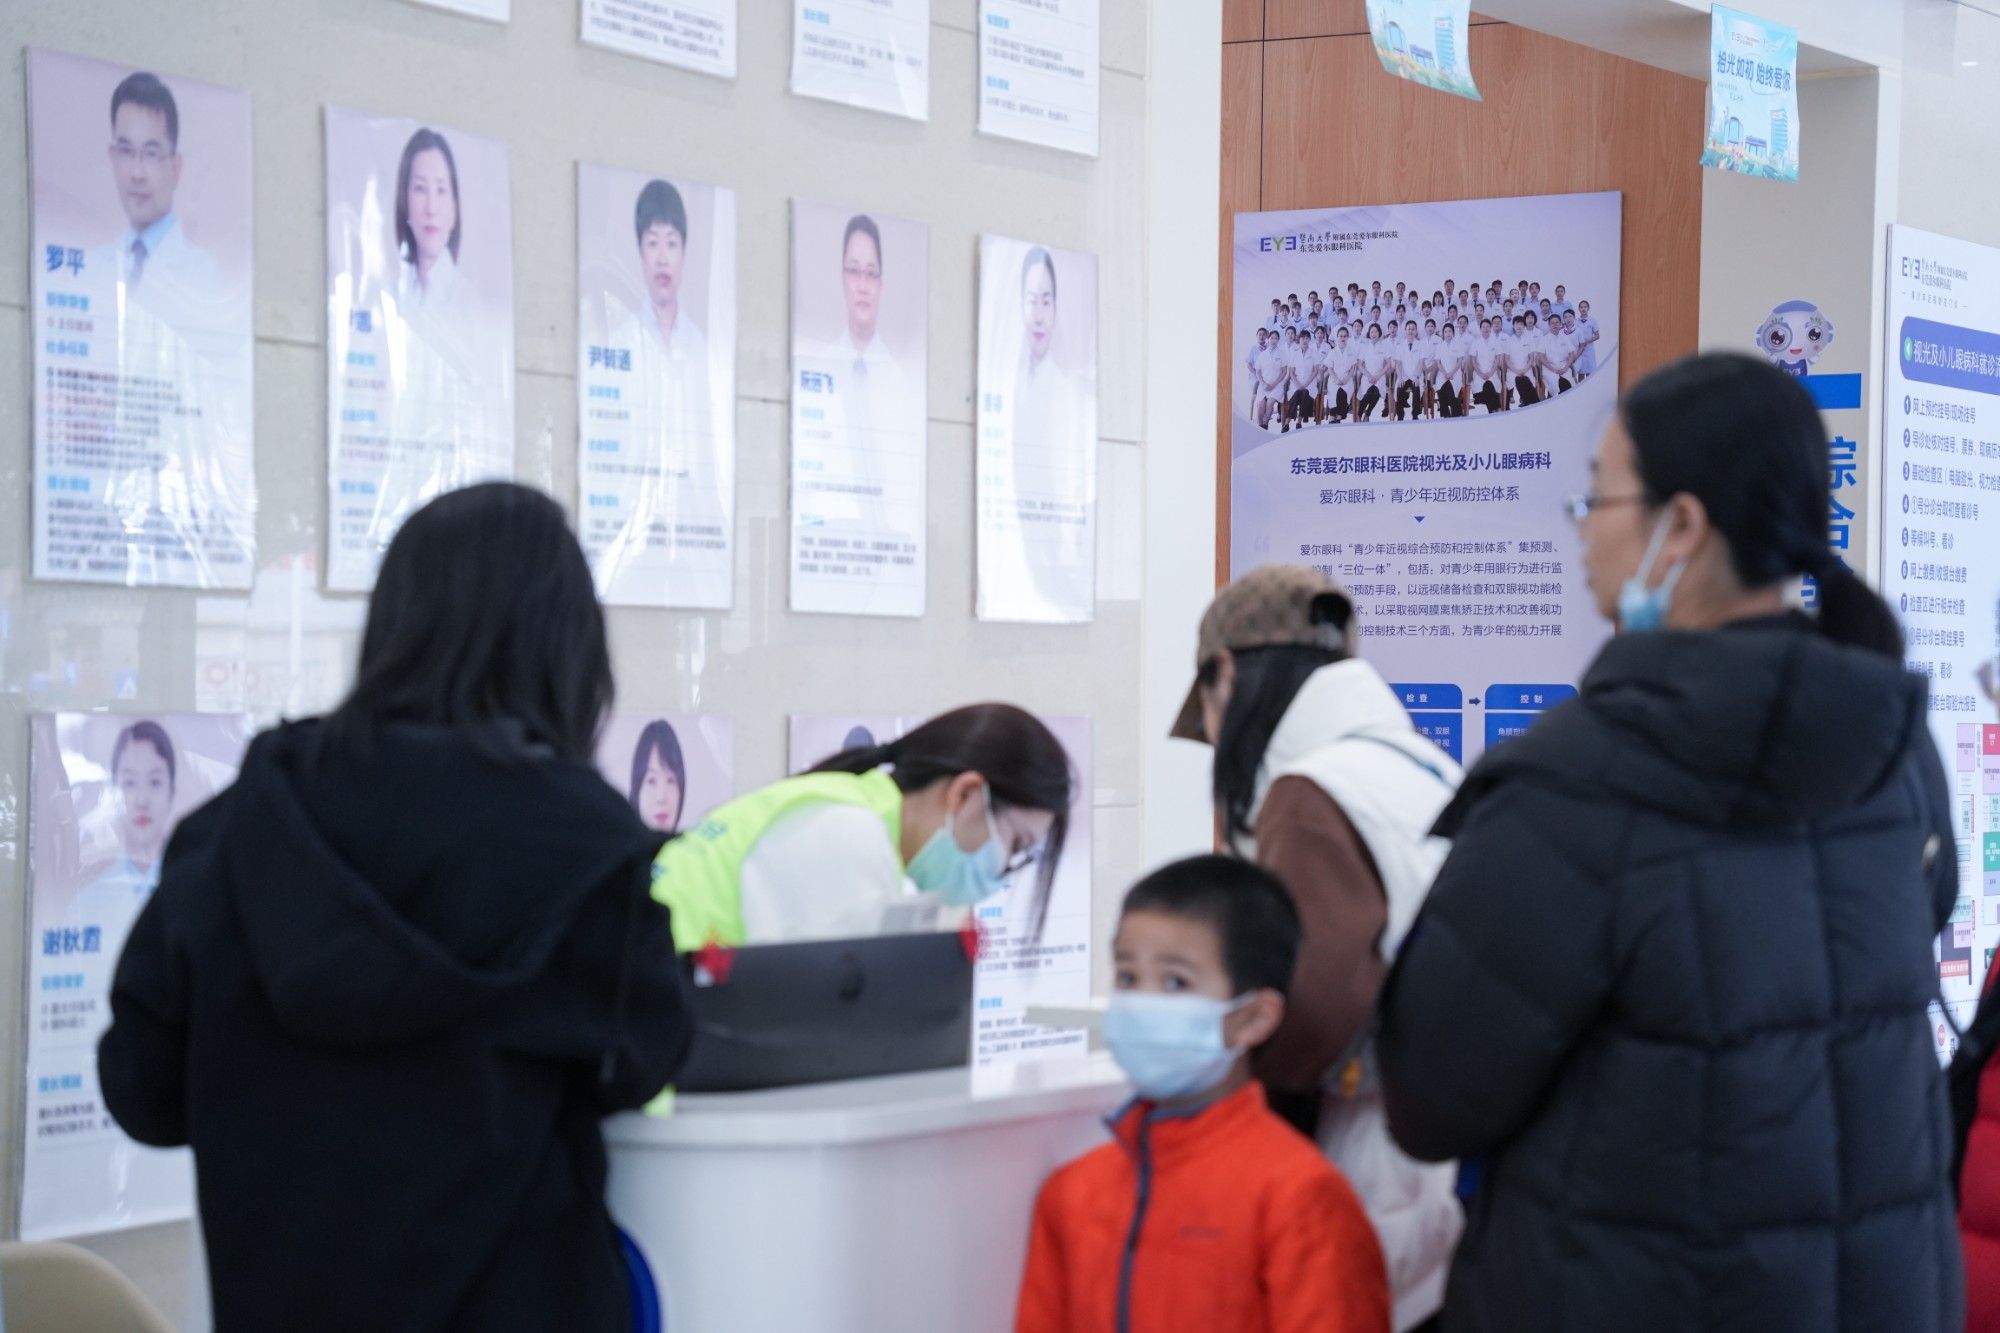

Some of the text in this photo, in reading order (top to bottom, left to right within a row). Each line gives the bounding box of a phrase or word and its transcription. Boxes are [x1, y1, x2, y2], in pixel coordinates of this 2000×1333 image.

[1300, 242, 1363, 253] 东莞爱尔眼科医院
[1291, 452, 1552, 475] 东莞爱尔眼科医院视光及小儿眼病科
